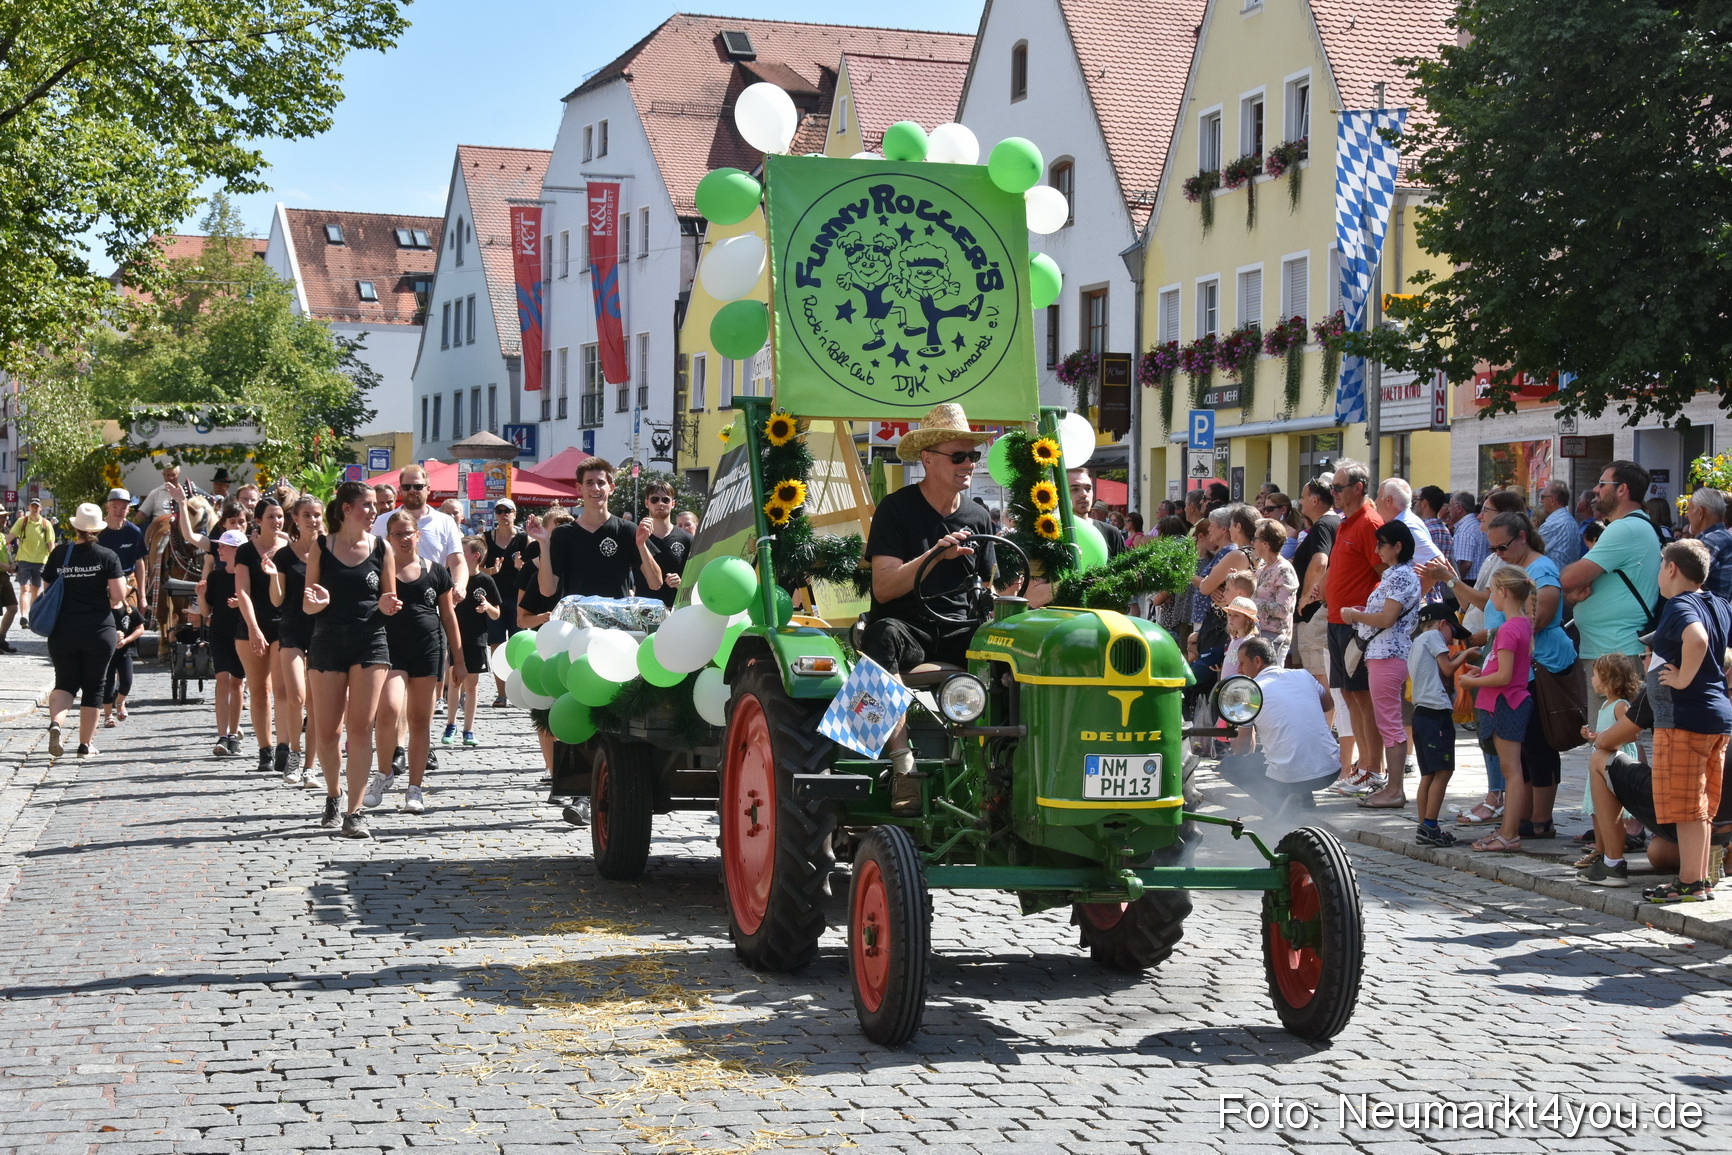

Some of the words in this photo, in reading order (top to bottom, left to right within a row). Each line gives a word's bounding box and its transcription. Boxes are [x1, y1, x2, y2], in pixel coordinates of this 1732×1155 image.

[590, 189, 608, 236] K&L
[607, 189, 615, 236] RUPPERT
[891, 374, 930, 398] DJK
[937, 334, 993, 385] Neumarkt
[1223, 390, 1238, 402] MEHR
[1404, 383, 1421, 399] KINO
[1435, 371, 1445, 424] INO
[1194, 415, 1209, 445] P
[987, 634, 1015, 647] DEUTZ
[1080, 730, 1162, 742] DEUTZ
[1102, 758, 1127, 777] NM
